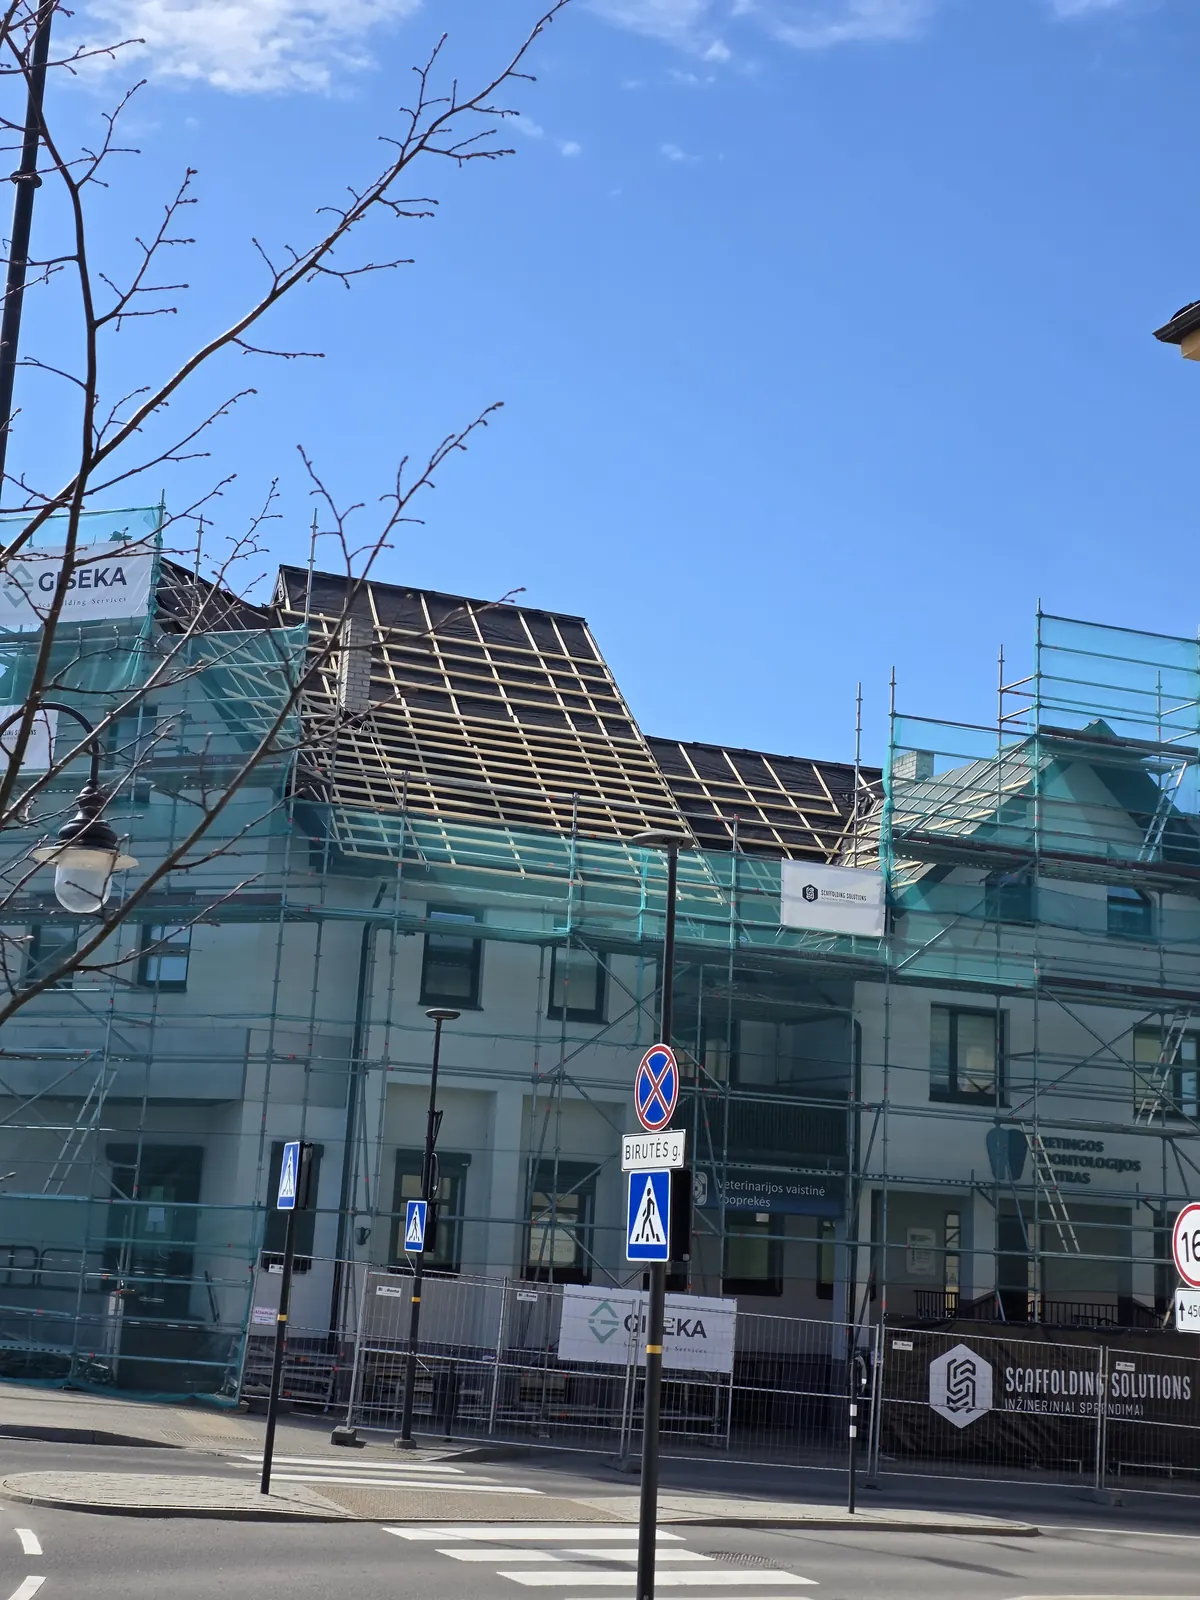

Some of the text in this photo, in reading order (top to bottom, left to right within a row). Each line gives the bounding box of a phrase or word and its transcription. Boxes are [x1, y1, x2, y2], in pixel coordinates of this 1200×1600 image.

[92, 597, 127, 605] Services
[846, 893, 867, 901] SOLUTIONS
[625, 1138, 681, 1162] BIRUTĖS g.
[786, 1185, 826, 1197] vaistinė
[1187, 1304, 1200, 1318] 45
[624, 1314, 707, 1339] GIEKA
[1005, 1366, 1191, 1400] SCAFFOLDING SOLUTIONS
[1004, 1396, 1075, 1413] INŽINERINIAI
